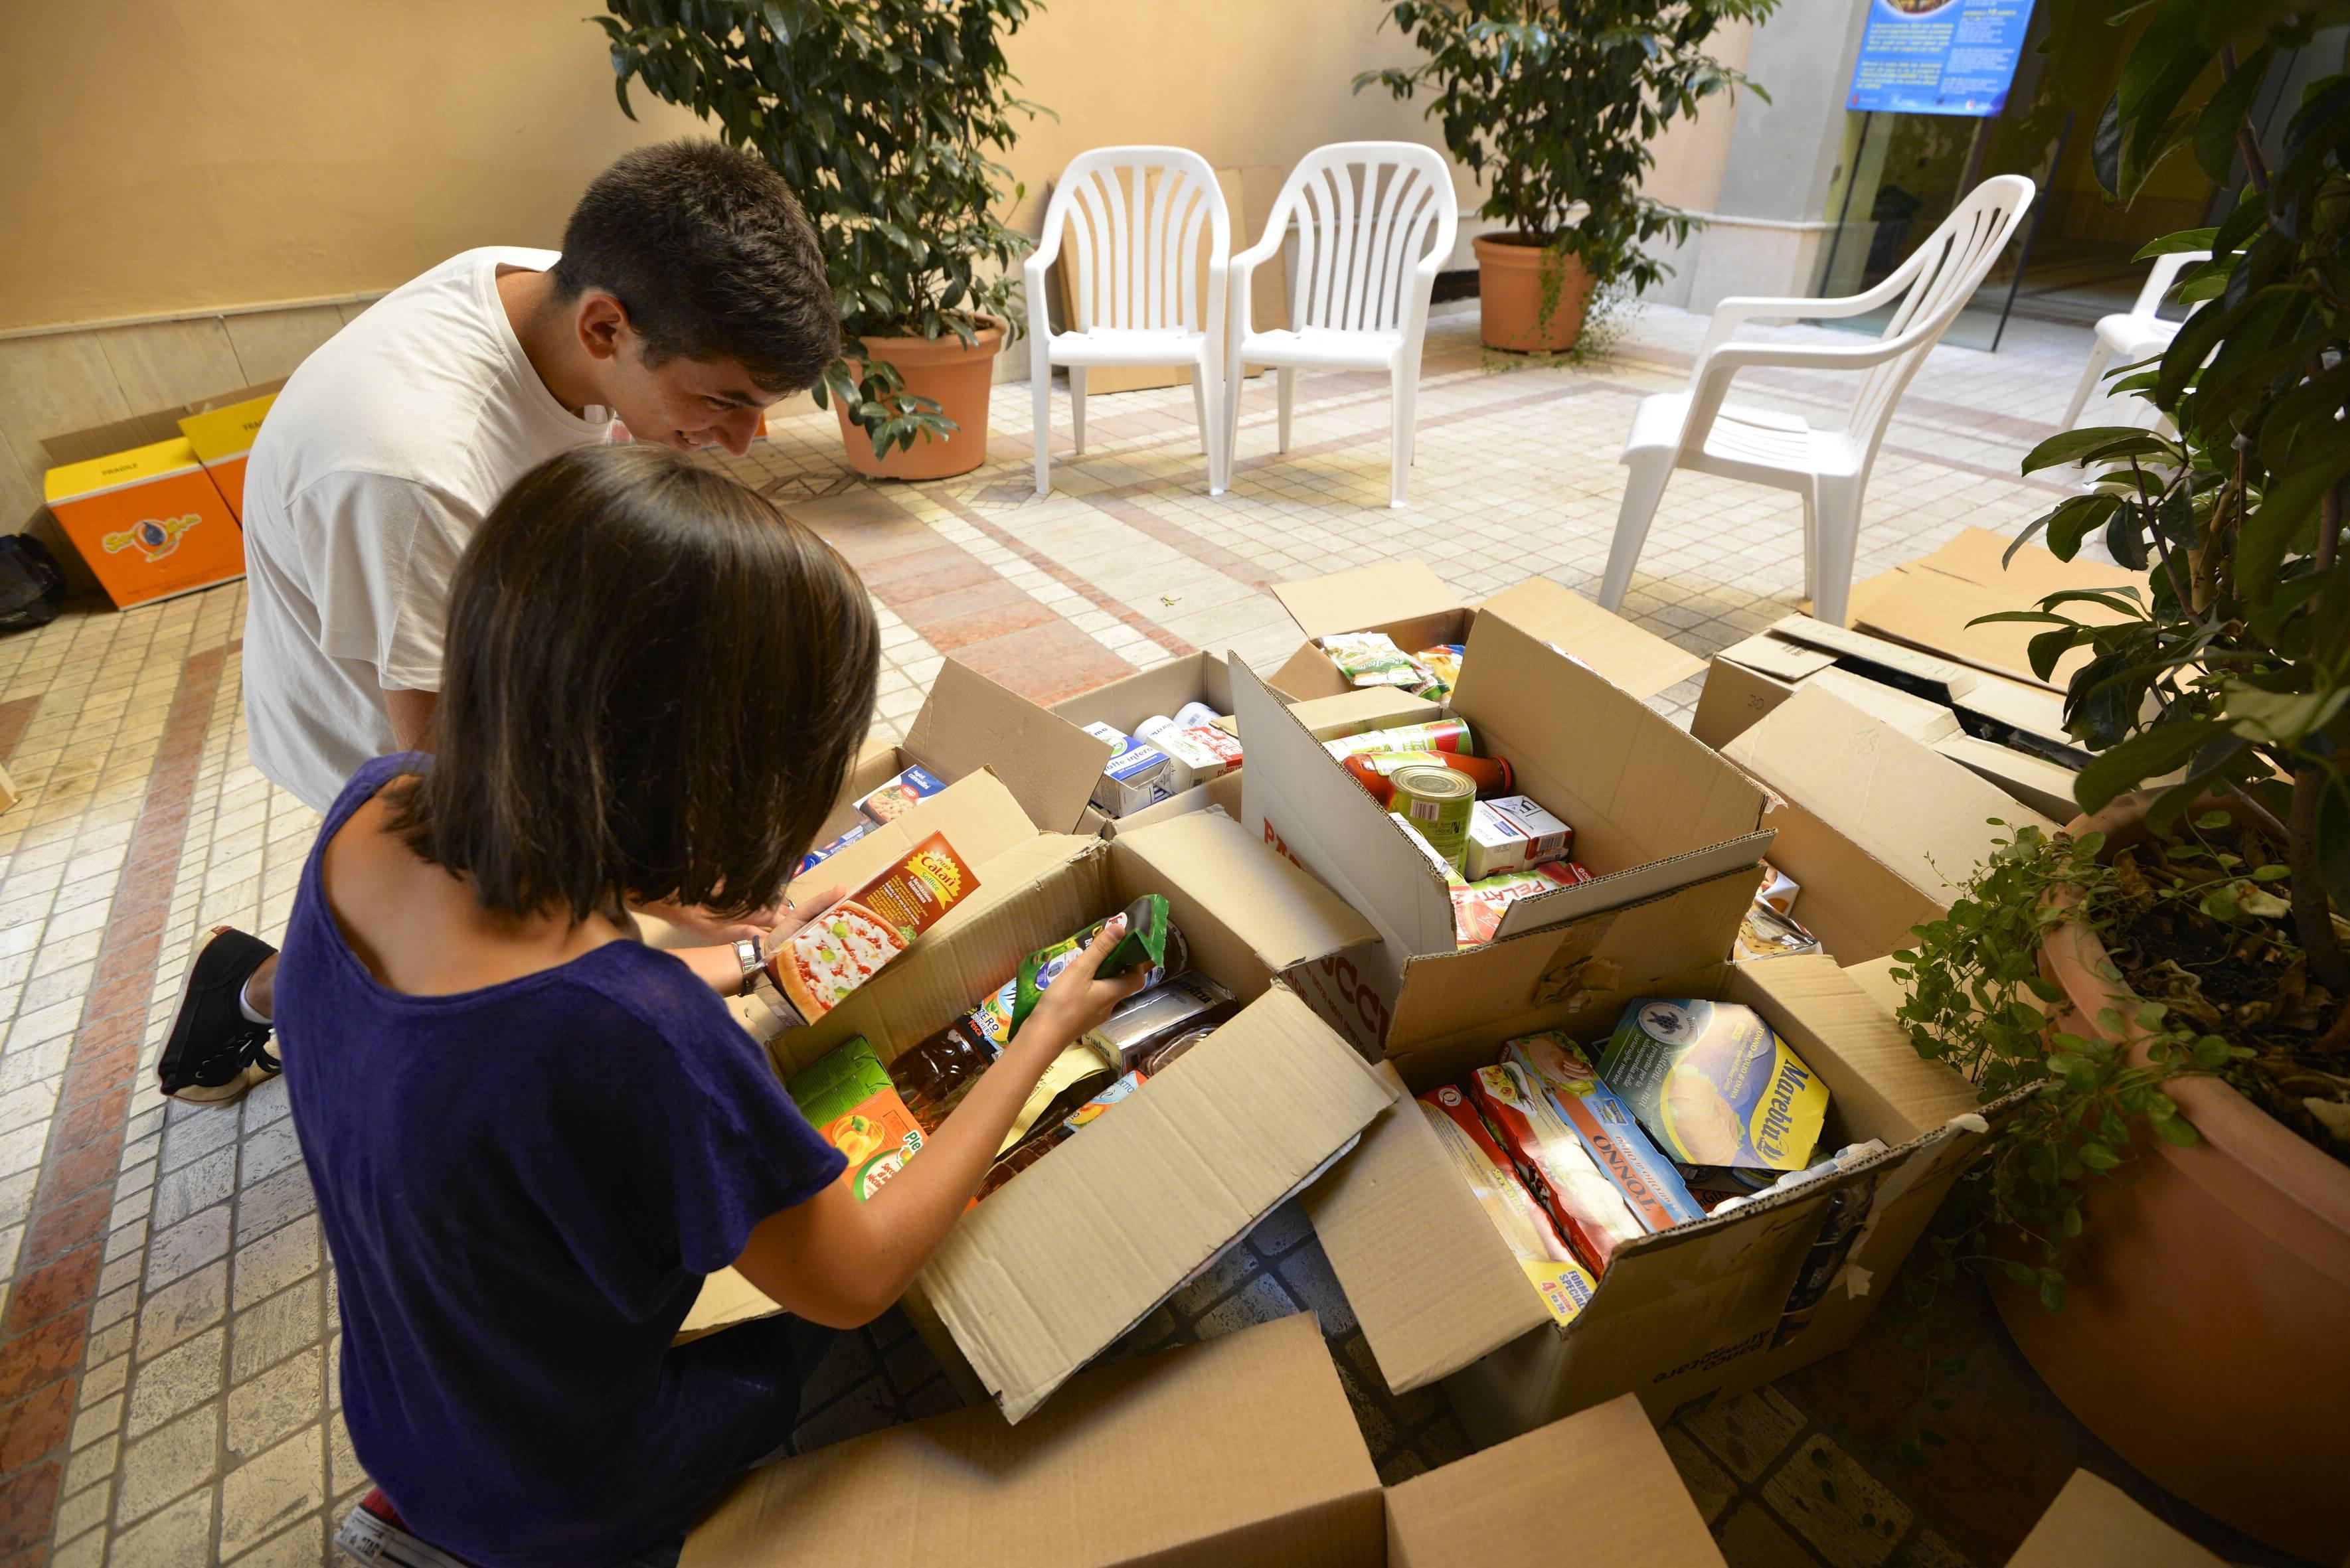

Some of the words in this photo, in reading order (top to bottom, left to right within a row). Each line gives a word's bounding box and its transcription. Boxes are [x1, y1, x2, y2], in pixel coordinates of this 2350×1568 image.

[243, 419, 264, 431] FRA
[102, 463, 137, 475] FRAGILE
[1127, 746, 1152, 761] intero
[920, 854, 956, 887] Catarì
[936, 858, 951, 870] Pizza
[907, 880, 926, 903] istantanea
[912, 878, 933, 902] lievitazione
[920, 872, 940, 891] Soffice
[1483, 881, 1547, 902] PELAT
[967, 1019, 982, 1036] Pesca
[971, 1014, 992, 1036] ZUCCHERO
[977, 1009, 999, 1033] ZERO
[1624, 1033, 1641, 1063] tartarughe
[1749, 1027, 1764, 1051] TONNO
[1630, 1038, 1650, 1073] salvaguardia
[1643, 1046, 1658, 1070] progetto
[1651, 1047, 1672, 1082] Sostieni
[1612, 1062, 1626, 1085] marine
[1623, 1073, 1635, 1087] delle
[1638, 1091, 1651, 1109] noi
[1730, 1080, 1742, 1099] OLIVA
[904, 1131, 922, 1151] Ple
[1614, 1136, 1637, 1162] Oliva
[1591, 1132, 1657, 1212] TONNO
[1541, 1282, 1556, 1292] 4
[1558, 1273, 1586, 1308] SPECIAL
[1568, 1269, 1592, 1300] FORMA
[1551, 1294, 1558, 1302] da
[1557, 1290, 1573, 1312] lattine
